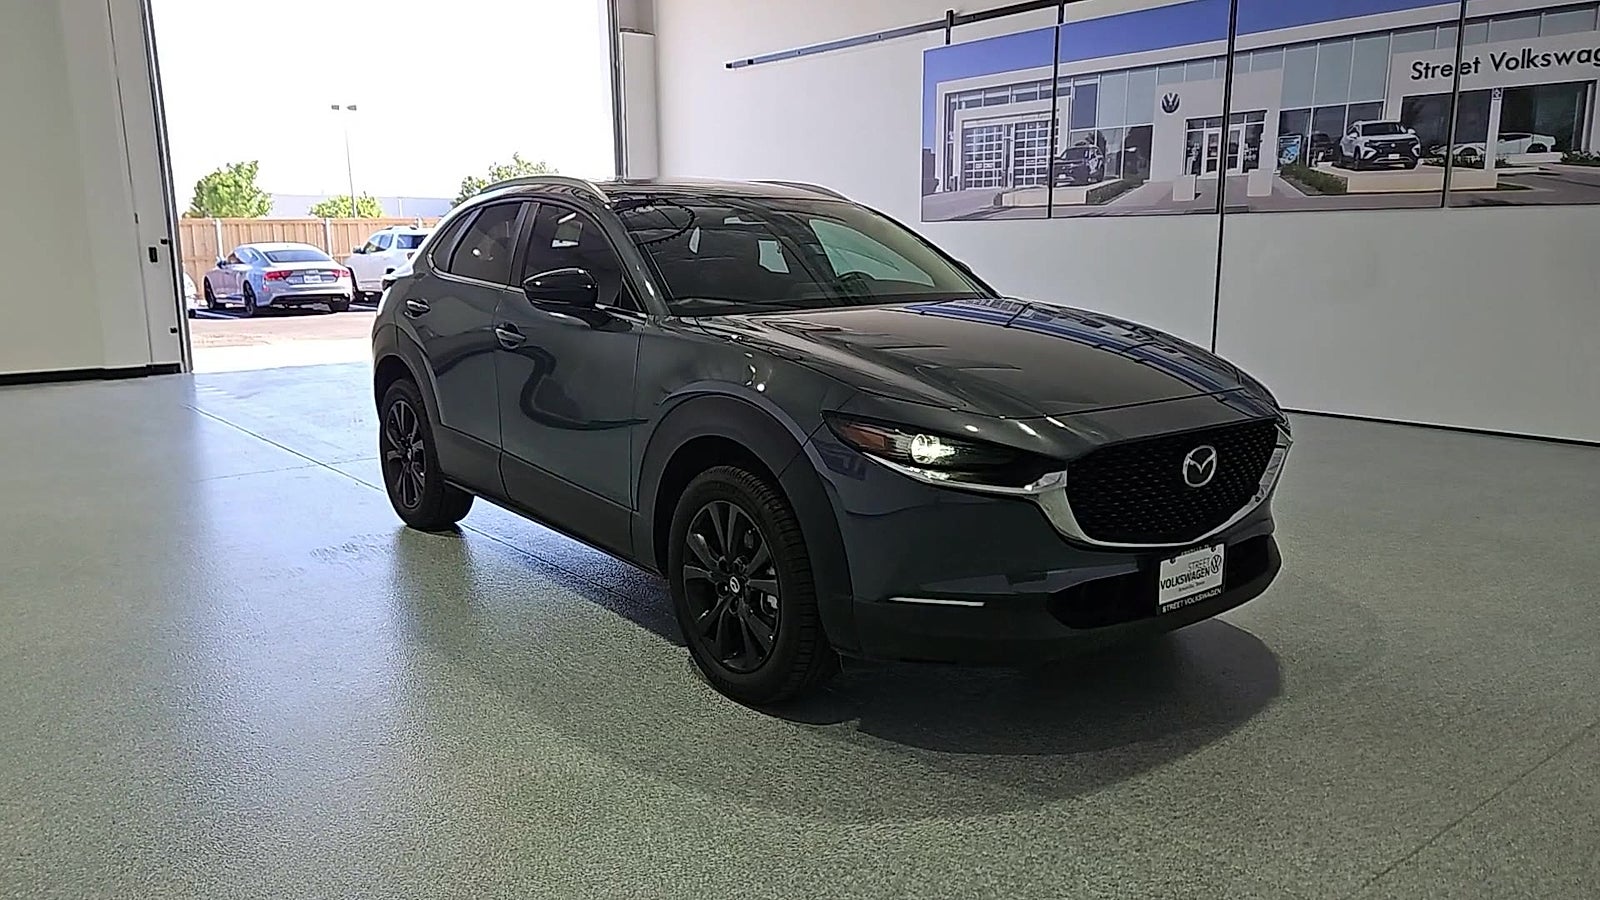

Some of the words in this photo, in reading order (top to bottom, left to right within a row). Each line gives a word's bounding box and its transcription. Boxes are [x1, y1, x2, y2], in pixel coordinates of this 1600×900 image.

[1411, 56, 1481, 80] Street
[1188, 557, 1210, 570] STREET
[1160, 567, 1211, 590] VOLKSWAGEN
